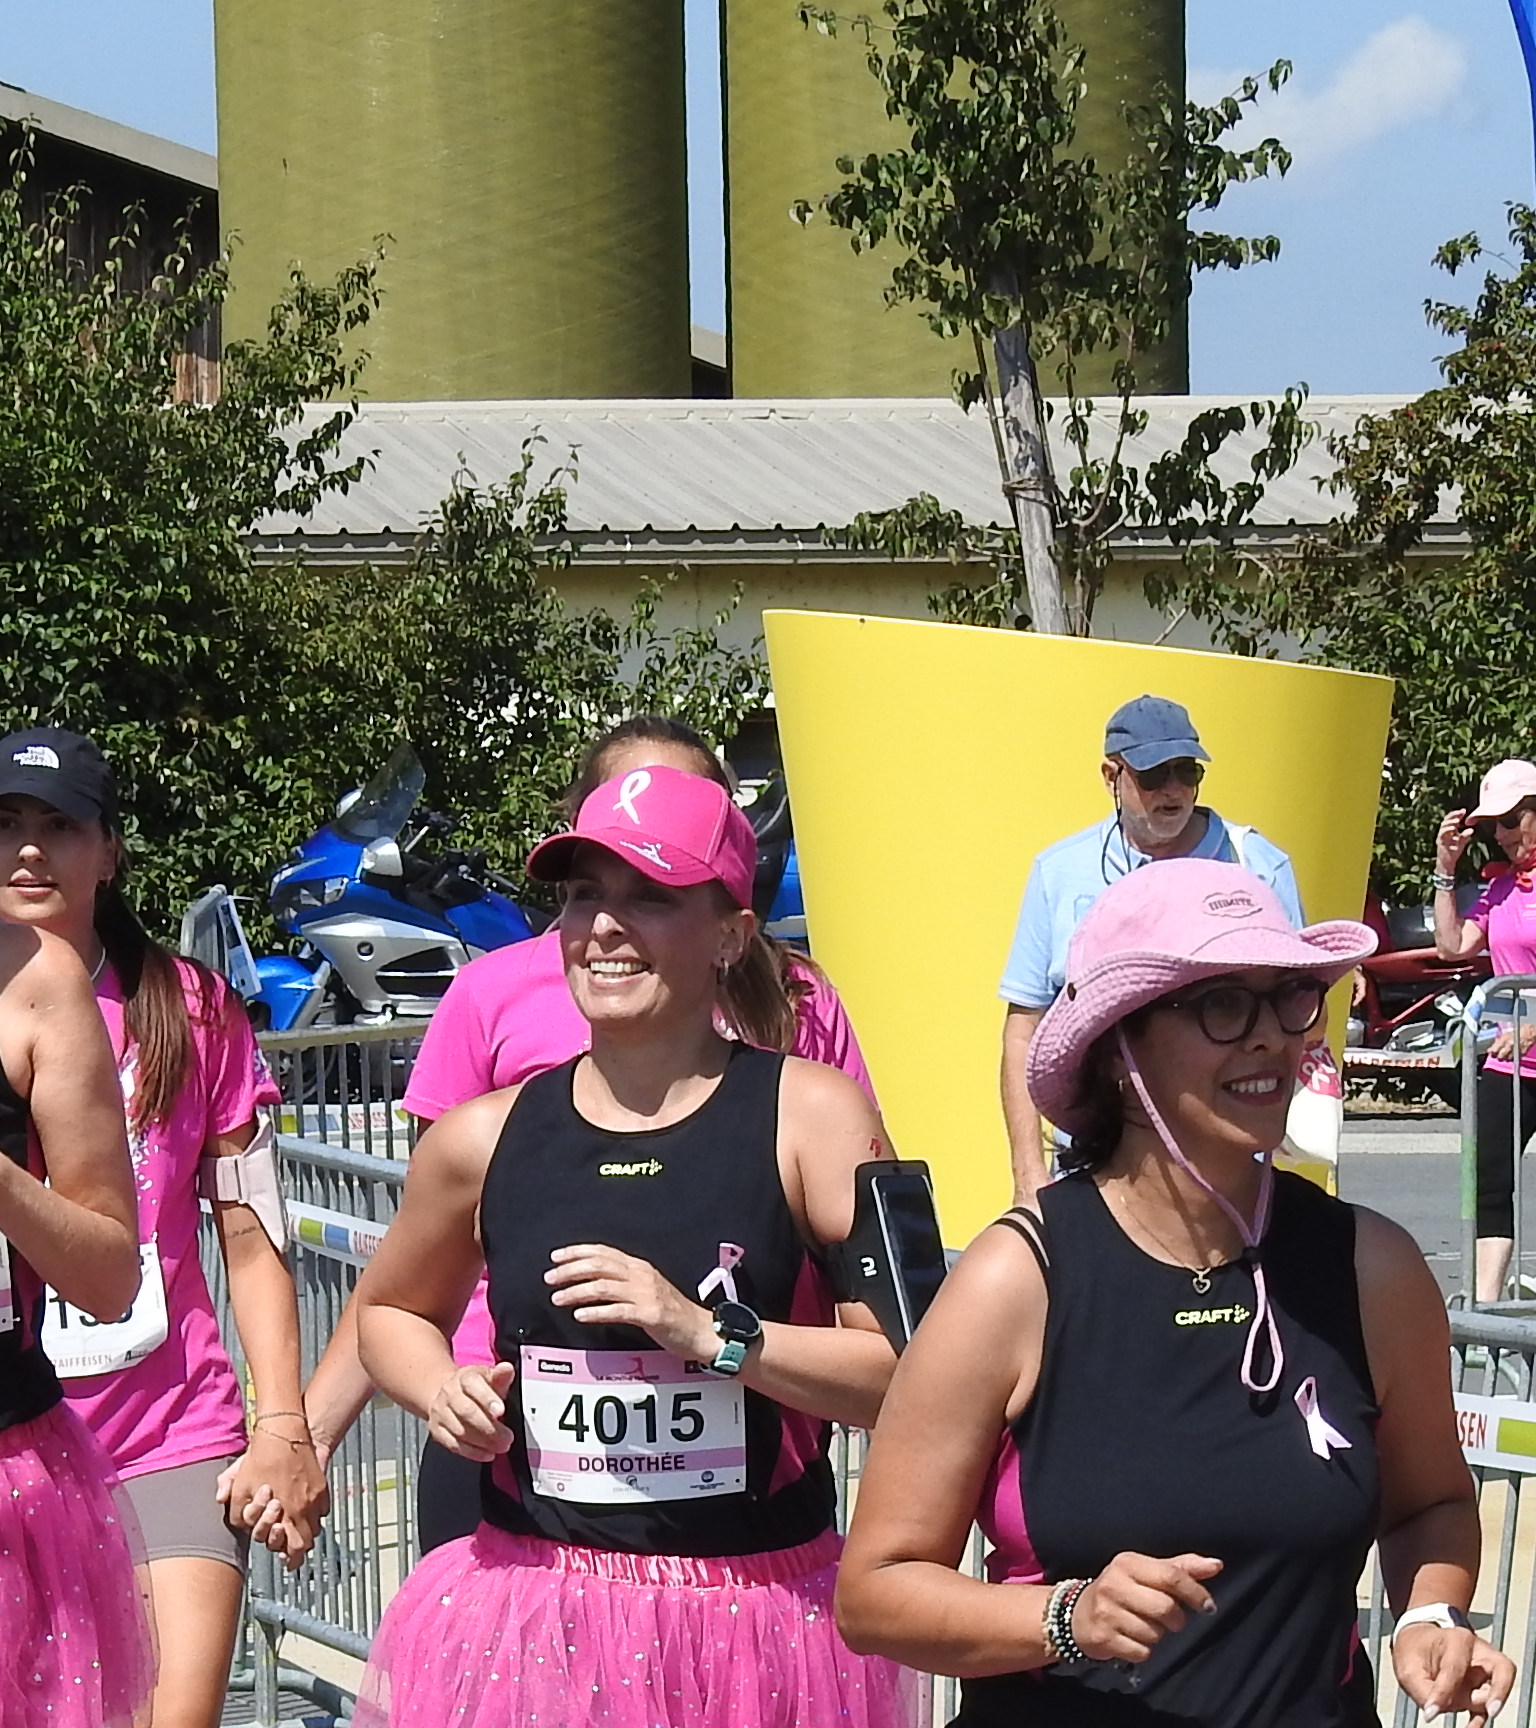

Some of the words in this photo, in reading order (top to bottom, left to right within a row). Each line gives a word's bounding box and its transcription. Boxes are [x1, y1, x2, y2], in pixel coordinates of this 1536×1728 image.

[599, 1162, 651, 1176] CRAFT
[1175, 1308, 1234, 1326] CRAFT
[558, 1391, 705, 1445] 4015
[578, 1451, 686, 1472] DOROTHÉE
